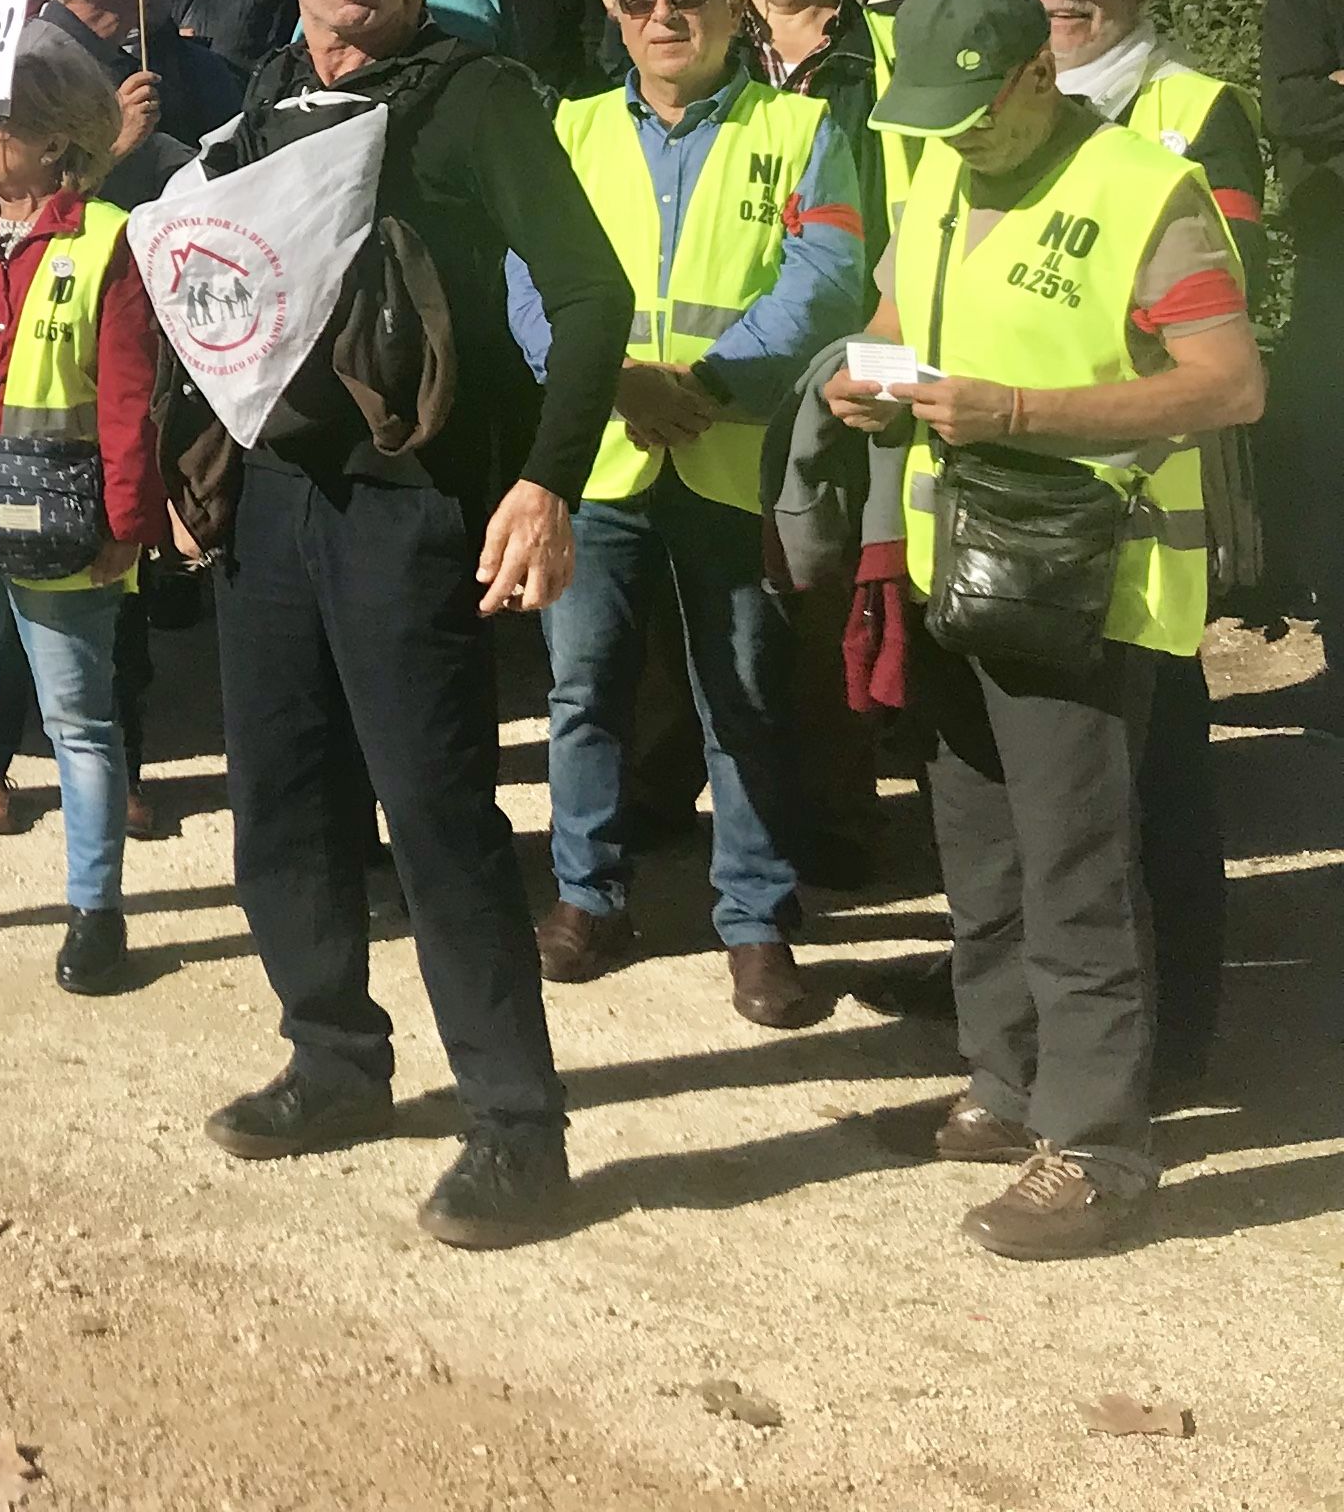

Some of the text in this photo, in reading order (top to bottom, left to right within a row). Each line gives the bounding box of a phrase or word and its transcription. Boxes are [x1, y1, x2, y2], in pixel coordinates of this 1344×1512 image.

[207, 217, 232, 230] POR
[233, 224, 248, 236] LA
[1037, 210, 1100, 258] NO
[1041, 251, 1064, 273] AL
